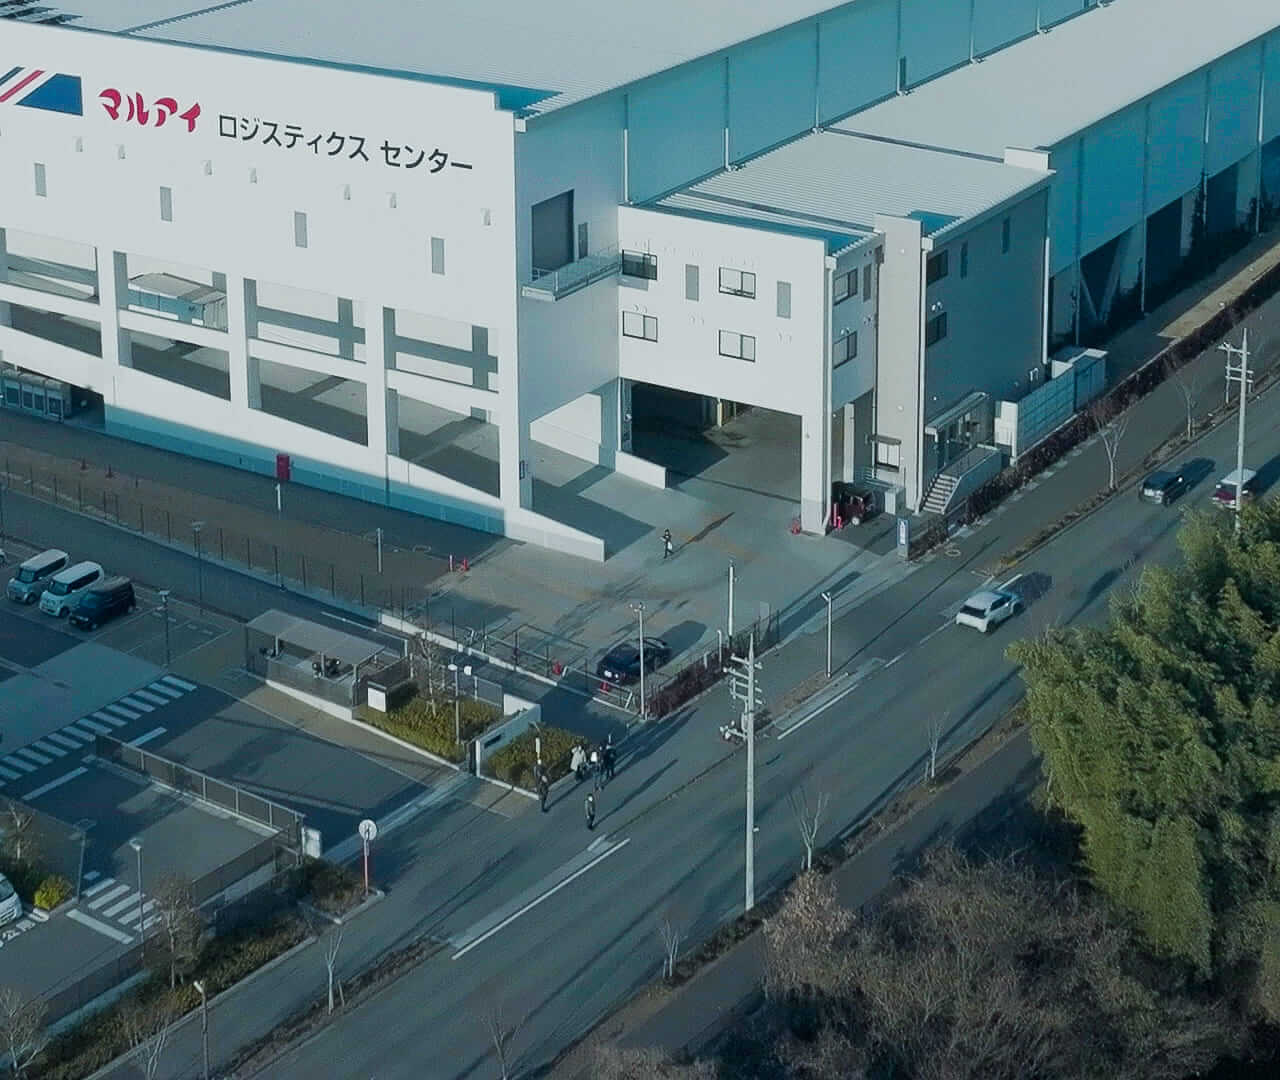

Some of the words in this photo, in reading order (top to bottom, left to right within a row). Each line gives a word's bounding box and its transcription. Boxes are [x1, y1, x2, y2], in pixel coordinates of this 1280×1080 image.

[99, 88, 201, 132] マルアイ
[219, 114, 369, 162] ロジスティクス
[380, 140, 473, 174] センター
